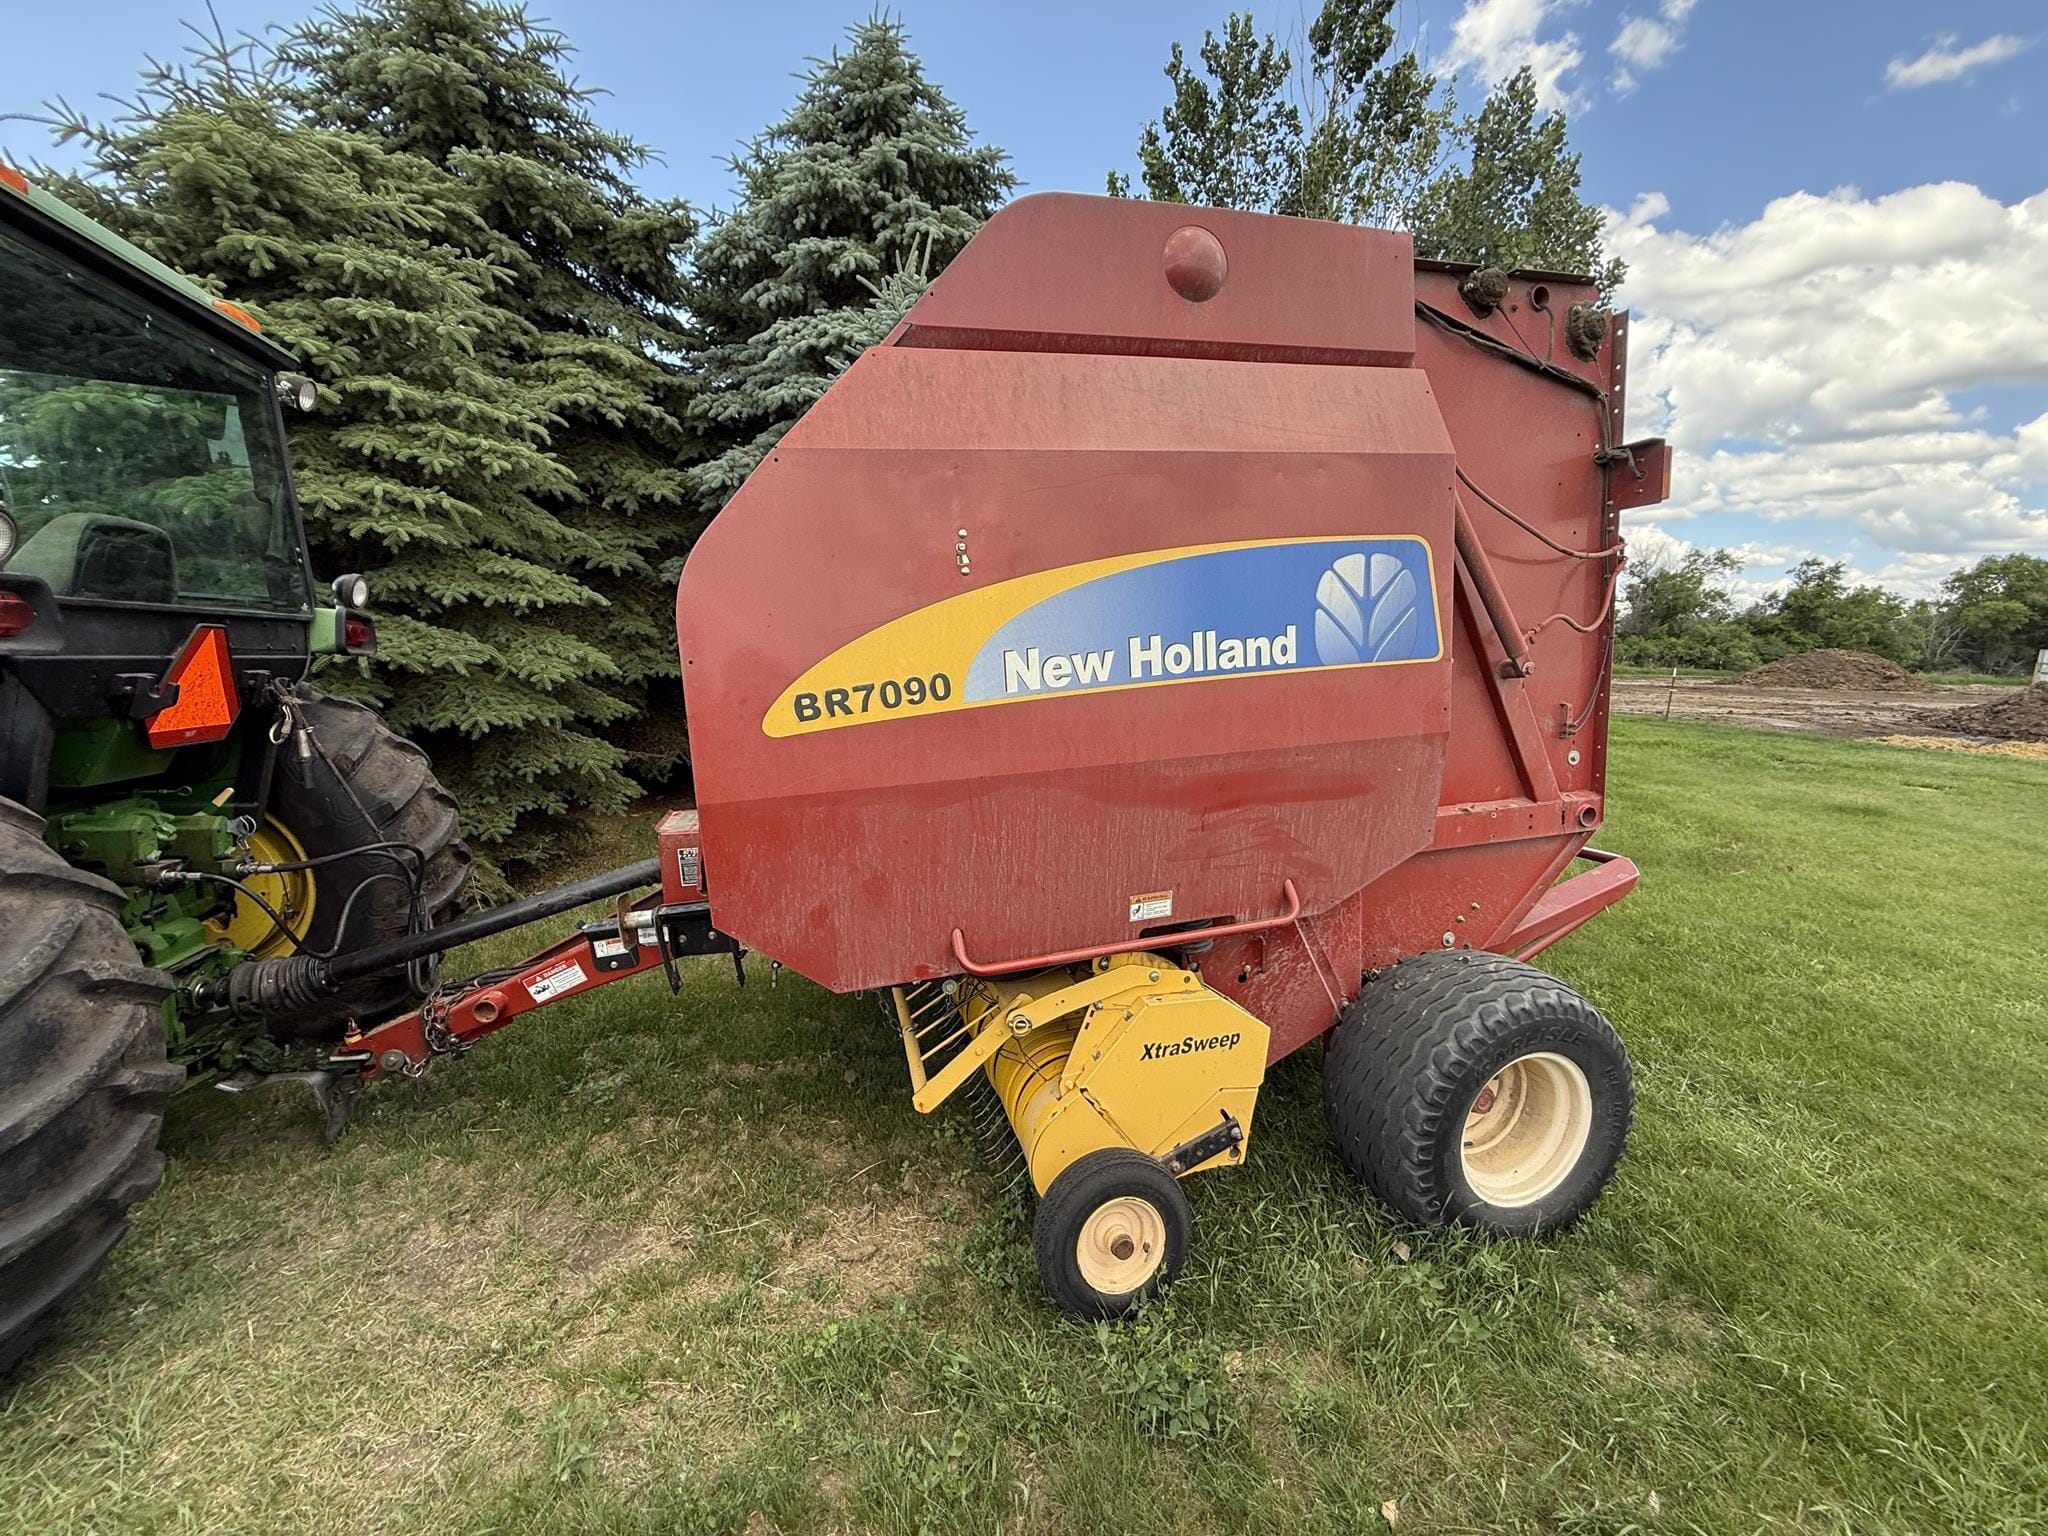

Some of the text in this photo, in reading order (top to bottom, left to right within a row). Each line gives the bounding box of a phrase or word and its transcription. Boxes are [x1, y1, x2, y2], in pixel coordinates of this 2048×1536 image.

[1003, 625, 1297, 693] New Holland
[794, 672, 952, 722] BR7090
[542, 963, 568, 979] DANGER
[1140, 1032, 1241, 1061] XtraSweep
[1475, 1025, 1589, 1086] CARLISLE
